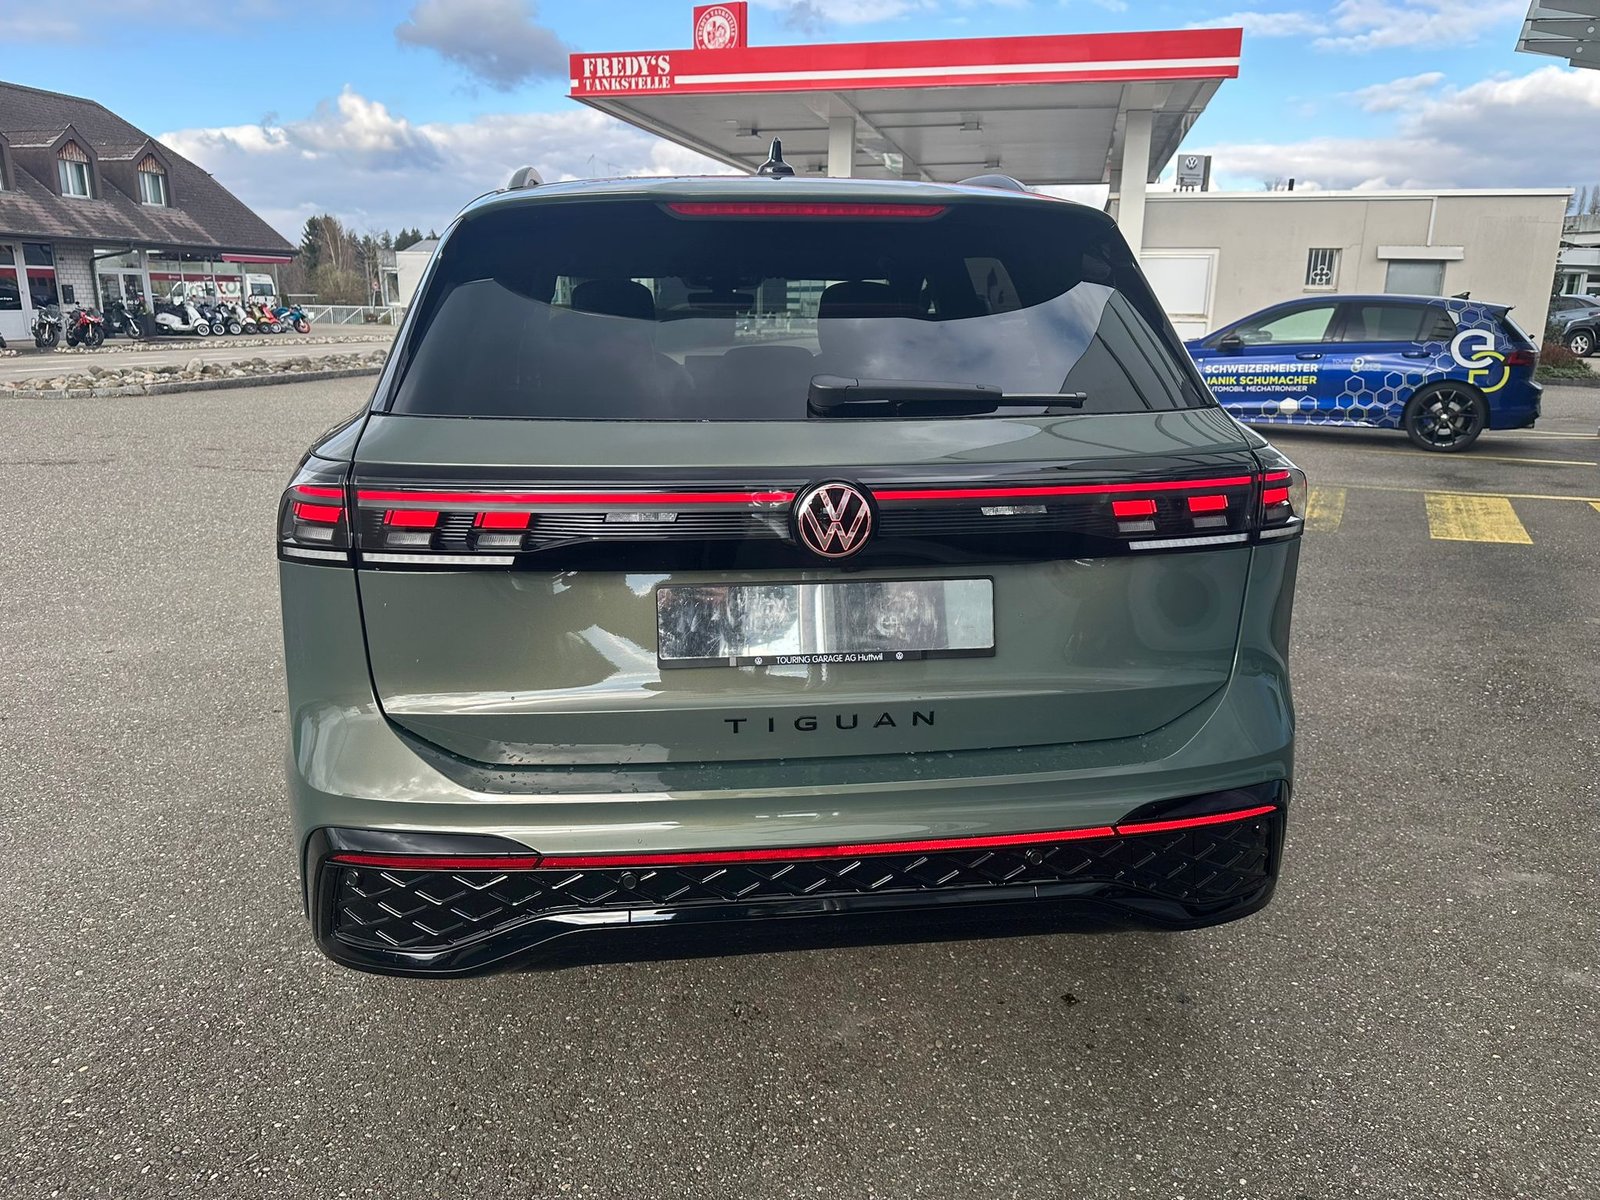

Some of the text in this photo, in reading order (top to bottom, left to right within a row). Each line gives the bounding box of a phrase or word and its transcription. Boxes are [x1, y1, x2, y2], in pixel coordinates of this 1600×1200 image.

[583, 75, 671, 91] TANKSTELLE
[1204, 363, 1319, 374] SCHWEIZERMEISTER
[1239, 375, 1317, 385] SCHUMACHER
[775, 652, 883, 665] TOURING GARAGE AG Huttwil
[724, 710, 936, 734] TIGUAN
